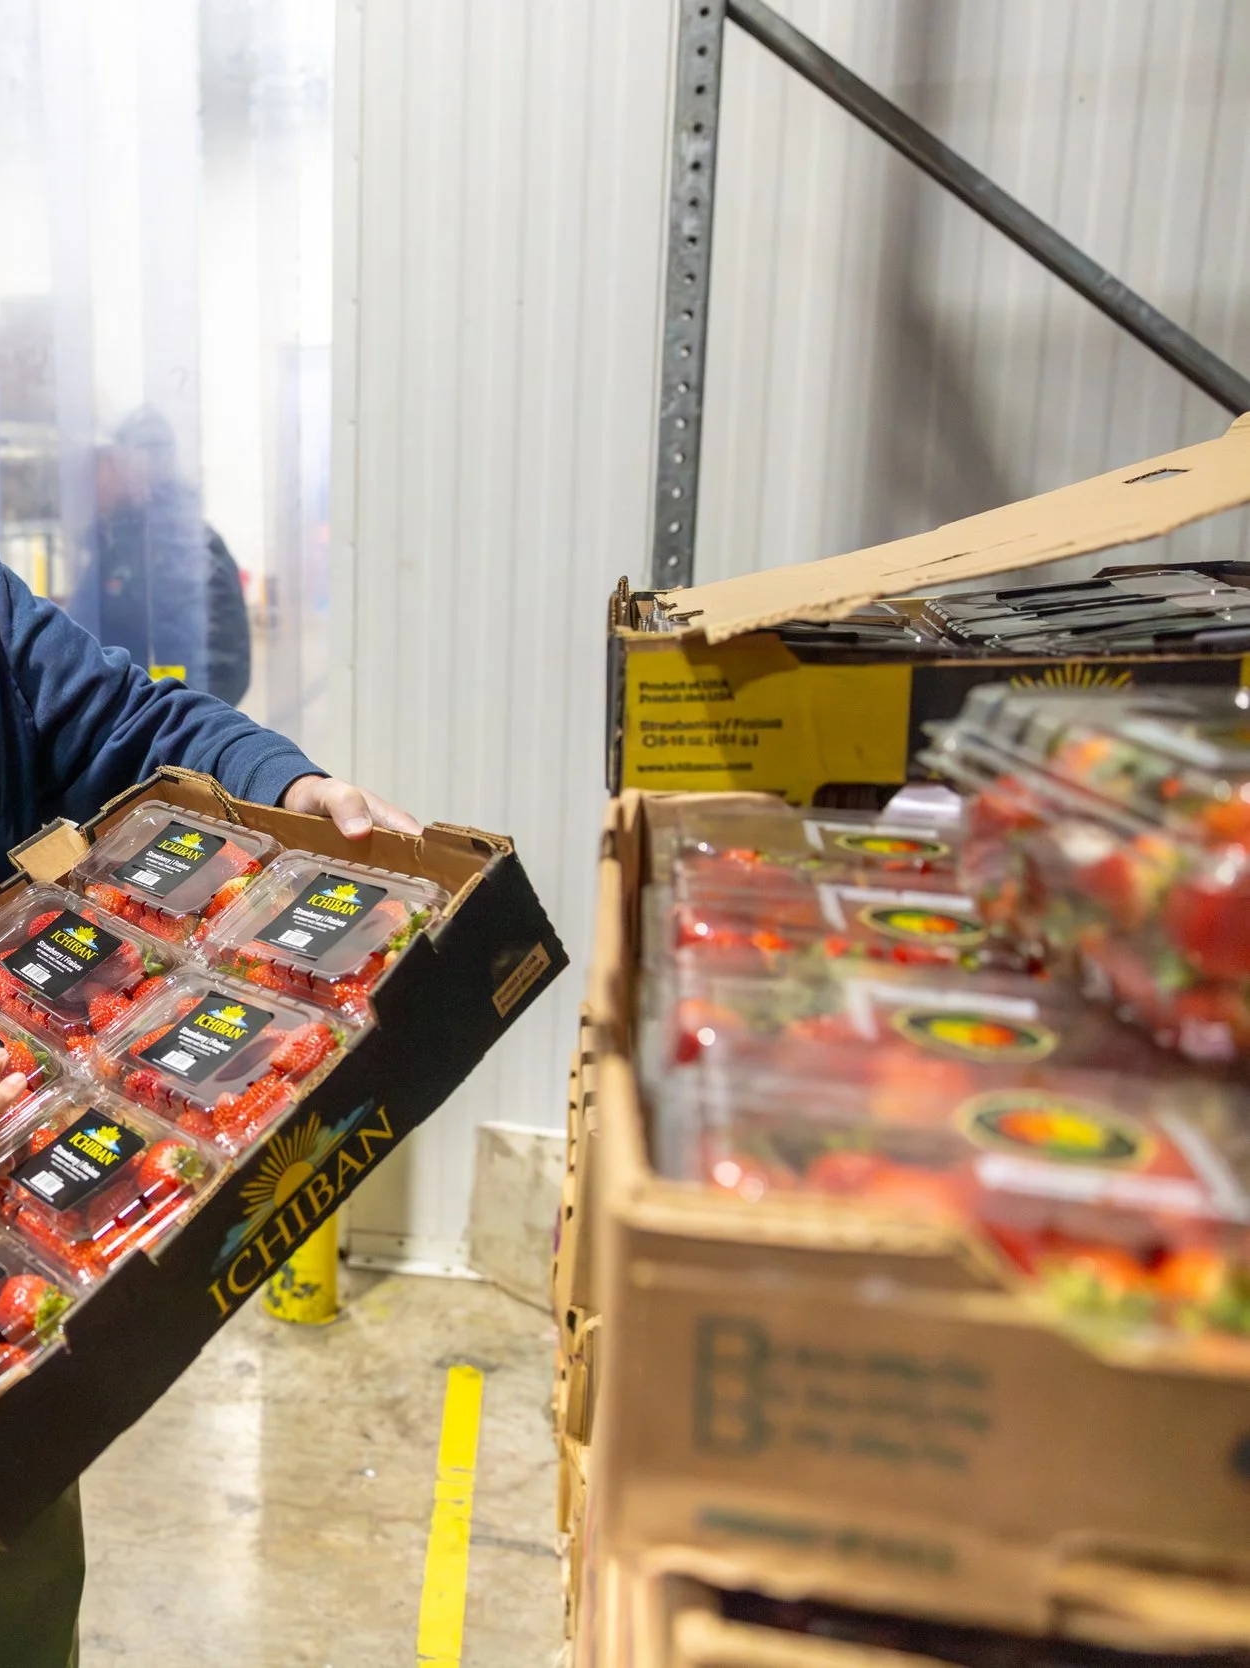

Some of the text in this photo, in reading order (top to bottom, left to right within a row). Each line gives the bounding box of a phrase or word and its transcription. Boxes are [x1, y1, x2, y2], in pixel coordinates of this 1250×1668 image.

[146, 850, 171, 865] Strawberry
[172, 859, 191, 871] Fraises
[158, 840, 203, 861] ICHIBAN
[306, 894, 360, 916] ICHIBAN
[293, 907, 323, 922] Strawberry
[325, 915, 347, 928] Fraises
[37, 940, 64, 960] Strawberry
[64, 955, 83, 971] Fraises
[50, 930, 98, 961] ICHIBAN
[179, 1026, 209, 1044] Strawberry
[194, 1013, 246, 1040] ICHIBAN
[68, 1131, 118, 1167] ICHIBAN
[207, 1105, 395, 1318] ICHIBAN
